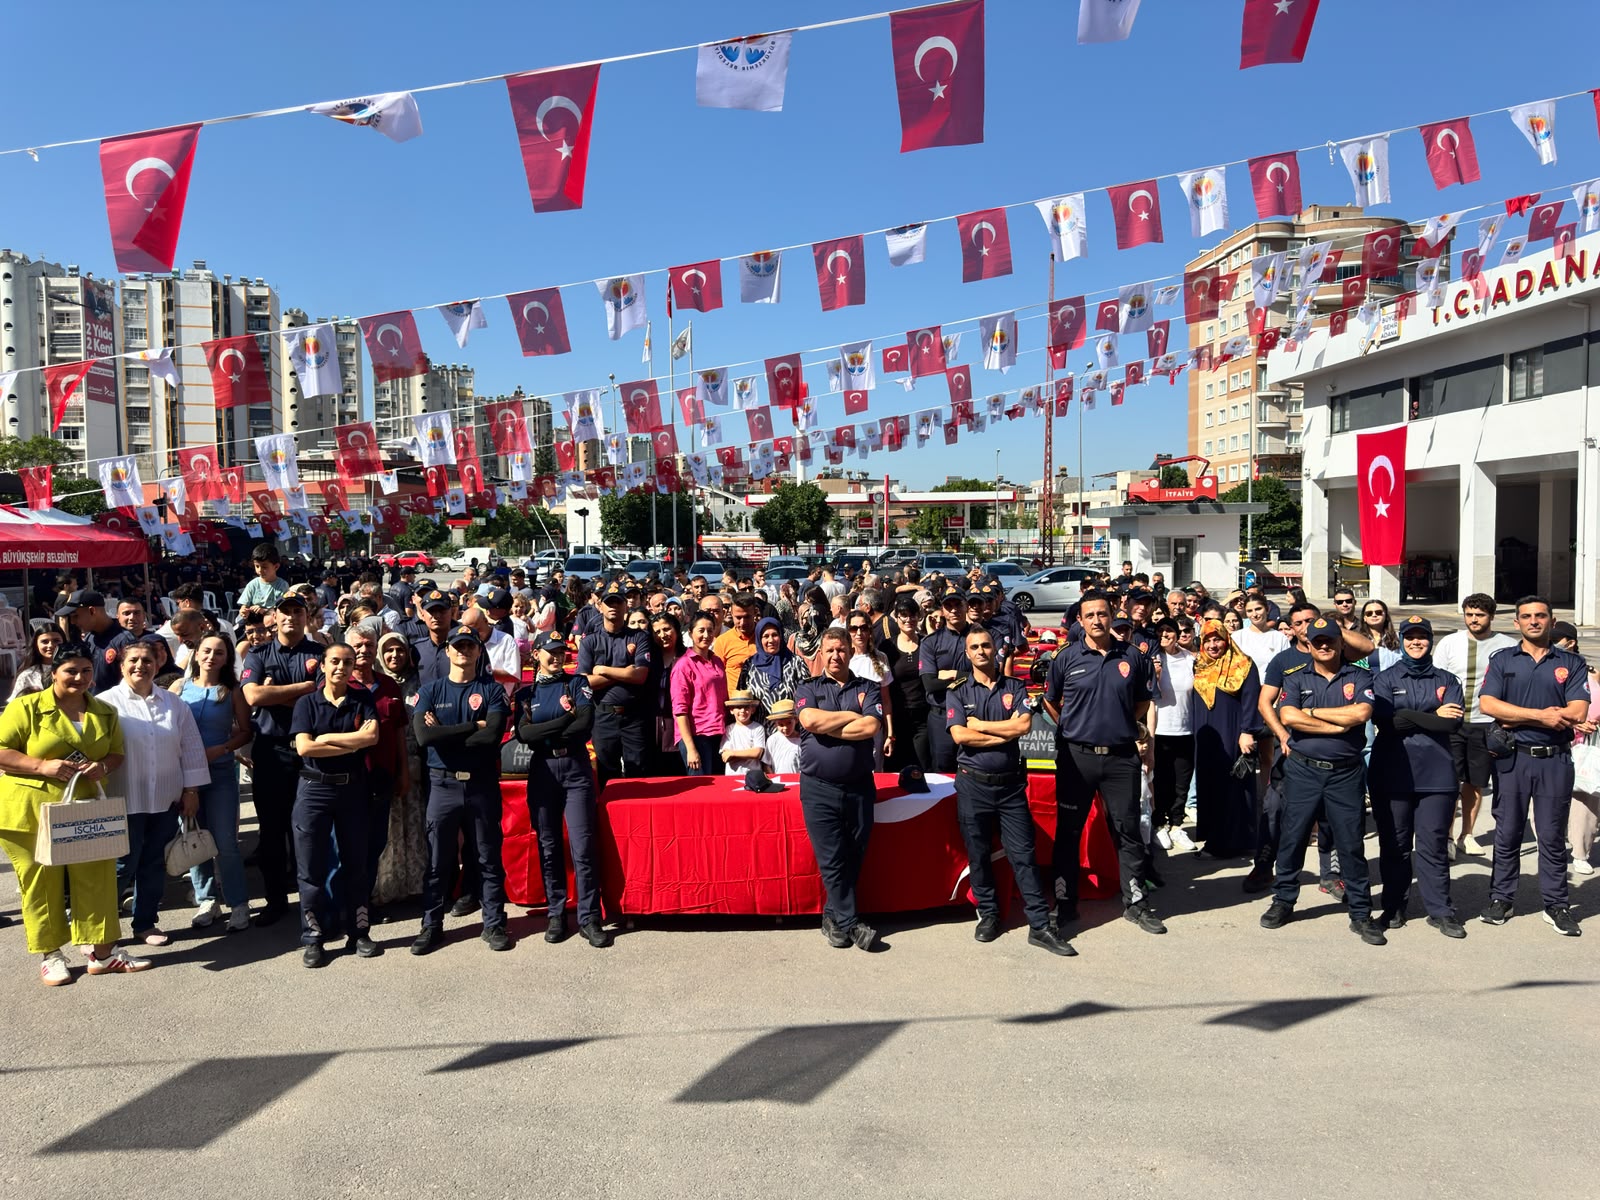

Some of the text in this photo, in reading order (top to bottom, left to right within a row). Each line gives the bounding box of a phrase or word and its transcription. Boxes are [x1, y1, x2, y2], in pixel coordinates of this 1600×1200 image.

[86, 322, 92, 336] 2
[86, 336, 93, 350] 2
[1165, 489, 1194, 497] İTFAİYE
[2, 549, 79, 566] BÜYÜKŞEHİR BELEDİYESİ
[74, 823, 106, 835] ISCHIA
